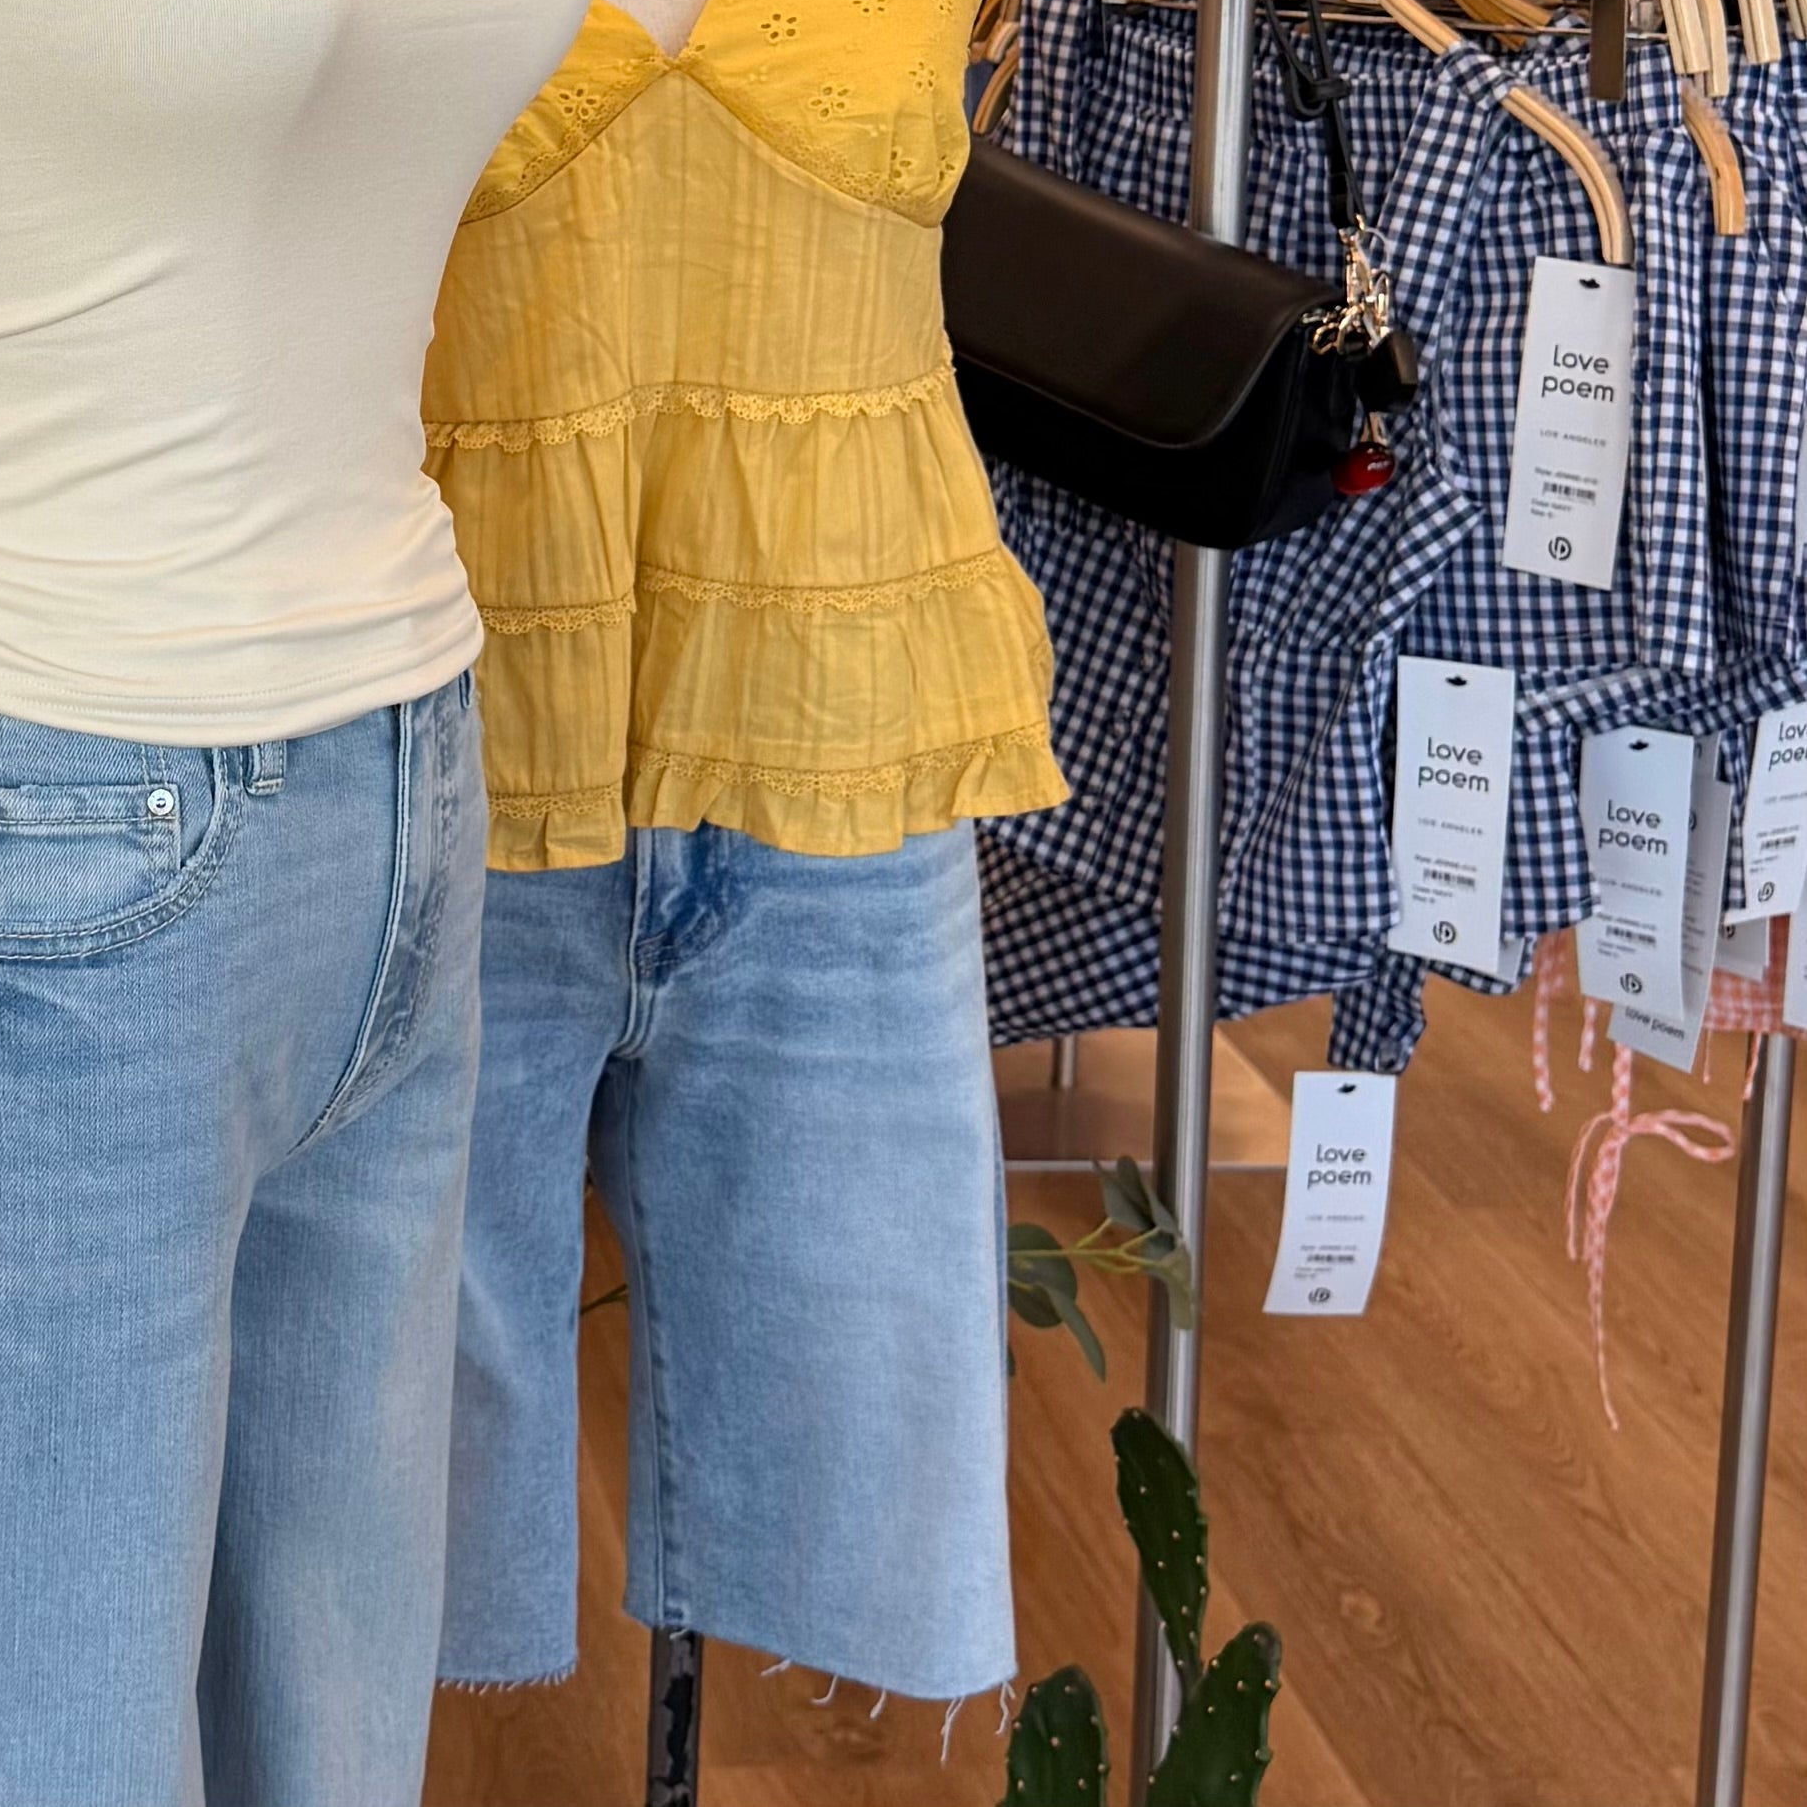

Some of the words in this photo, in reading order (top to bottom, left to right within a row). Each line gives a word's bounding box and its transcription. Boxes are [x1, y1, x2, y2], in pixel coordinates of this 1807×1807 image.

[1541, 374, 1615, 403] poem
[1778, 720, 1807, 742] lov
[1768, 745, 1807, 772] poe
[1418, 766, 1490, 793] poem
[1598, 828, 1669, 856] poem
[1651, 1017, 1685, 1040] poem
[1307, 1168, 1372, 1190] poem
